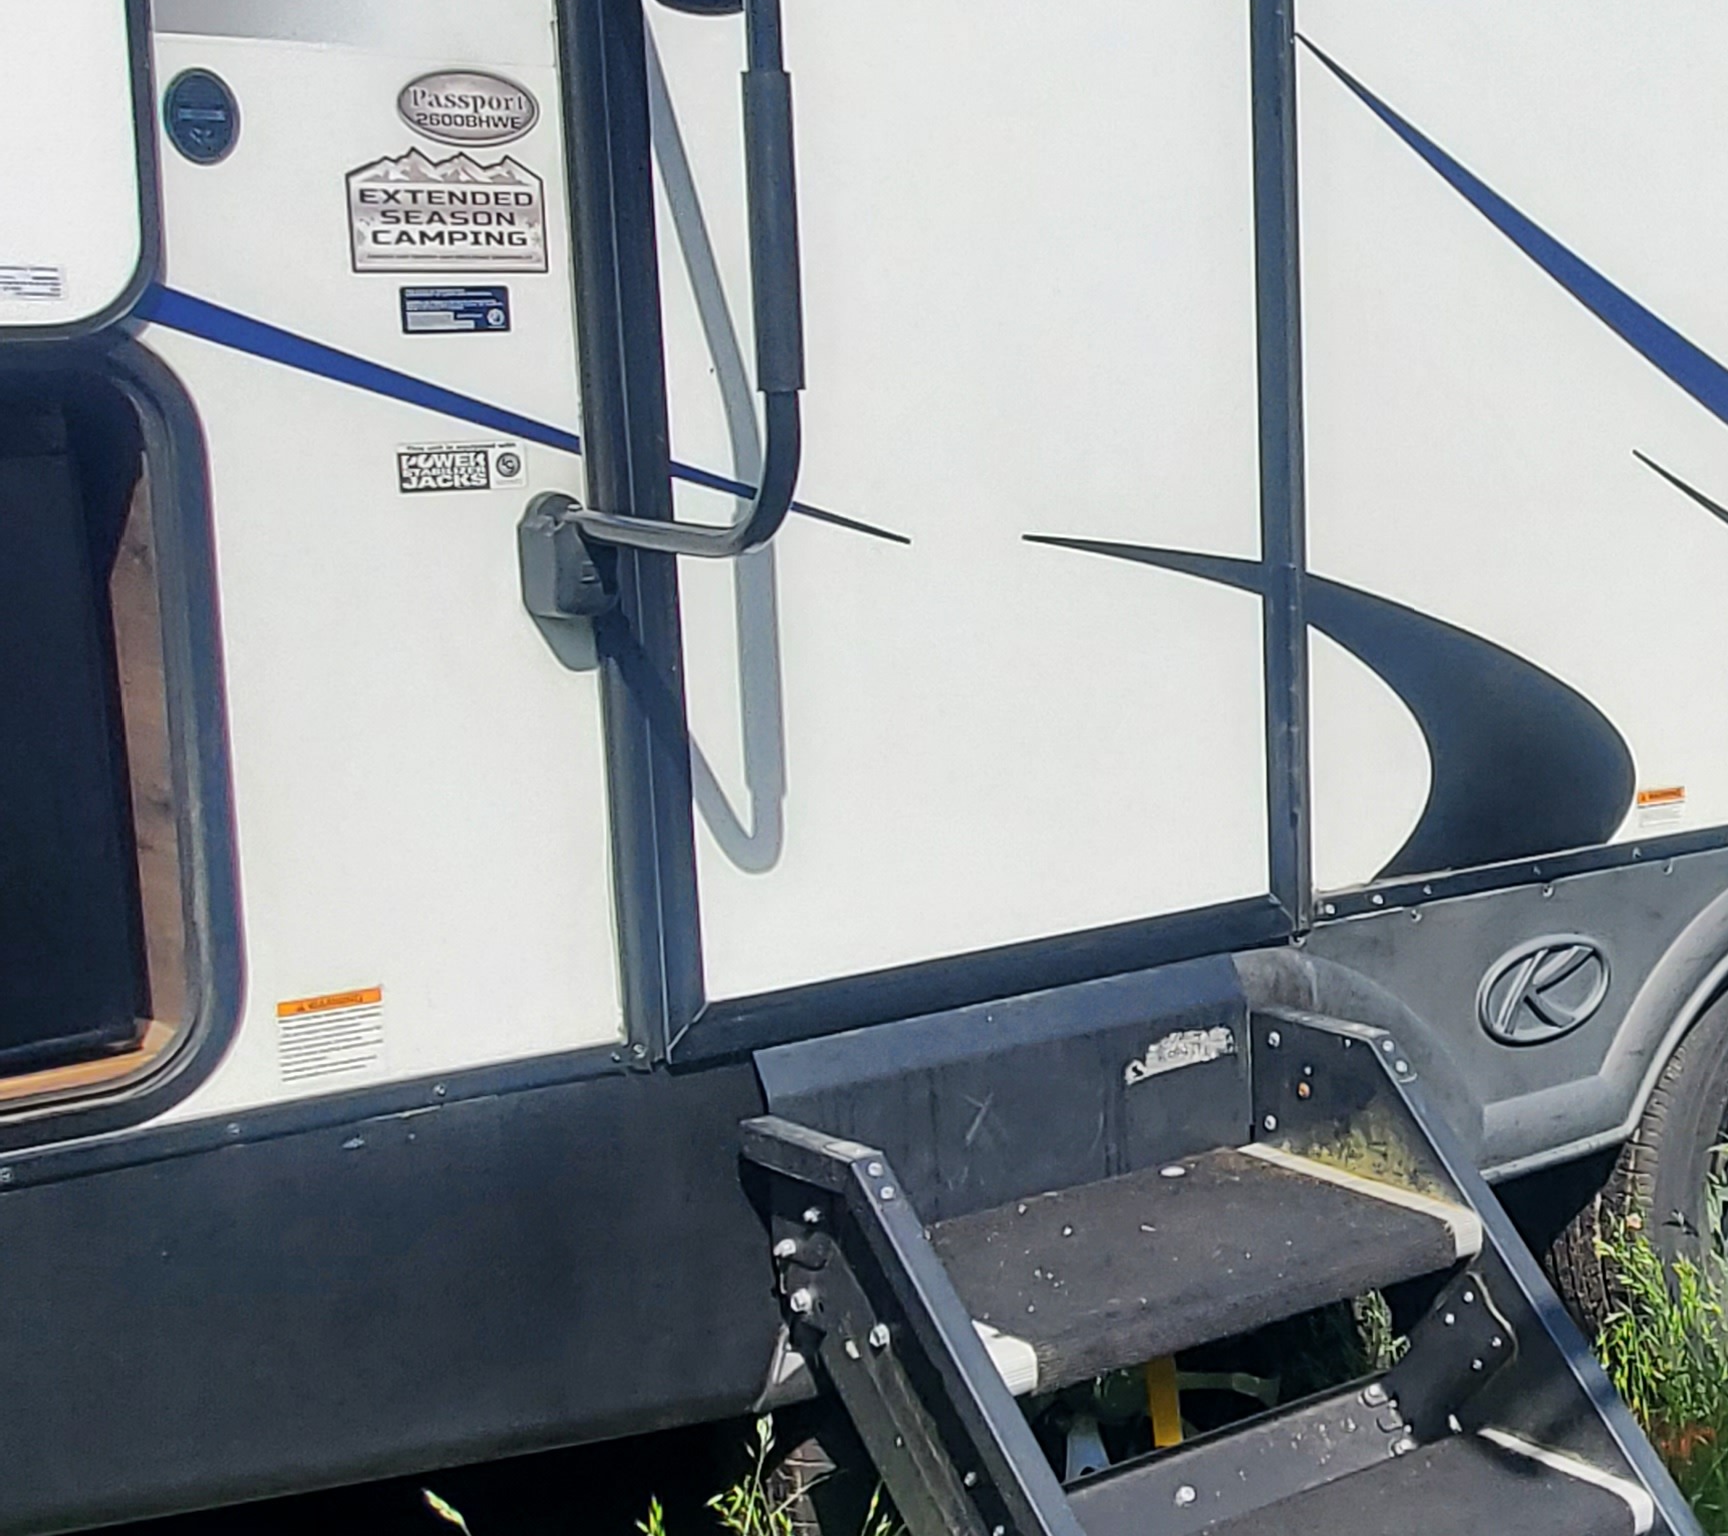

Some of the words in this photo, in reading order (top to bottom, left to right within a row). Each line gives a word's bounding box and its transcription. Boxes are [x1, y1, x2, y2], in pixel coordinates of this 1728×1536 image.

[412, 87, 525, 115] Passport
[358, 188, 533, 206] EXTENDED
[380, 210, 516, 226] SEASON
[371, 230, 528, 247] CAMPING
[402, 475, 488, 489] JACKS
